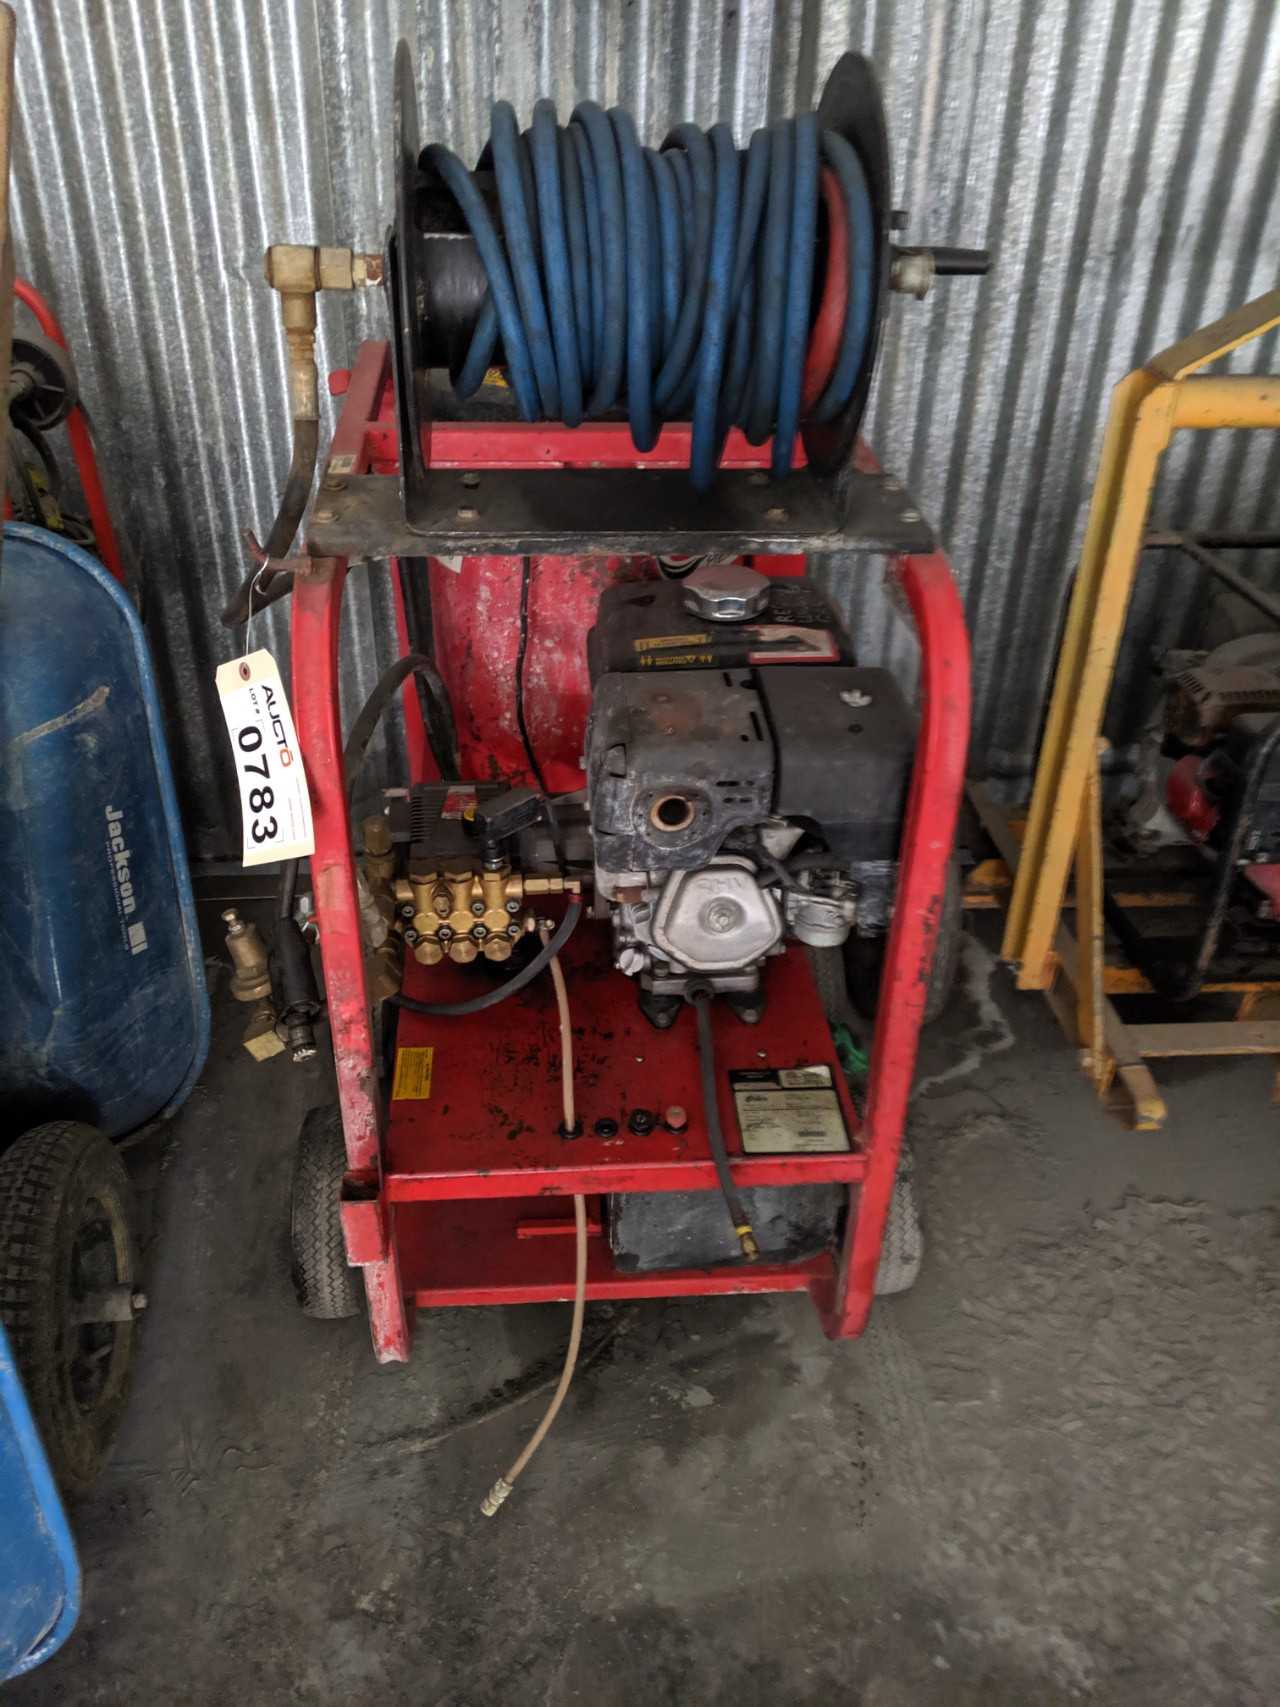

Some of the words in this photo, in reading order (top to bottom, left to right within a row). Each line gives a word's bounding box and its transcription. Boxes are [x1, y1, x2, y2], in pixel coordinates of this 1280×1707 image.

[249, 688, 259, 705] LOT
[238, 725, 278, 844] 0783
[104, 804, 136, 915] Jackson
